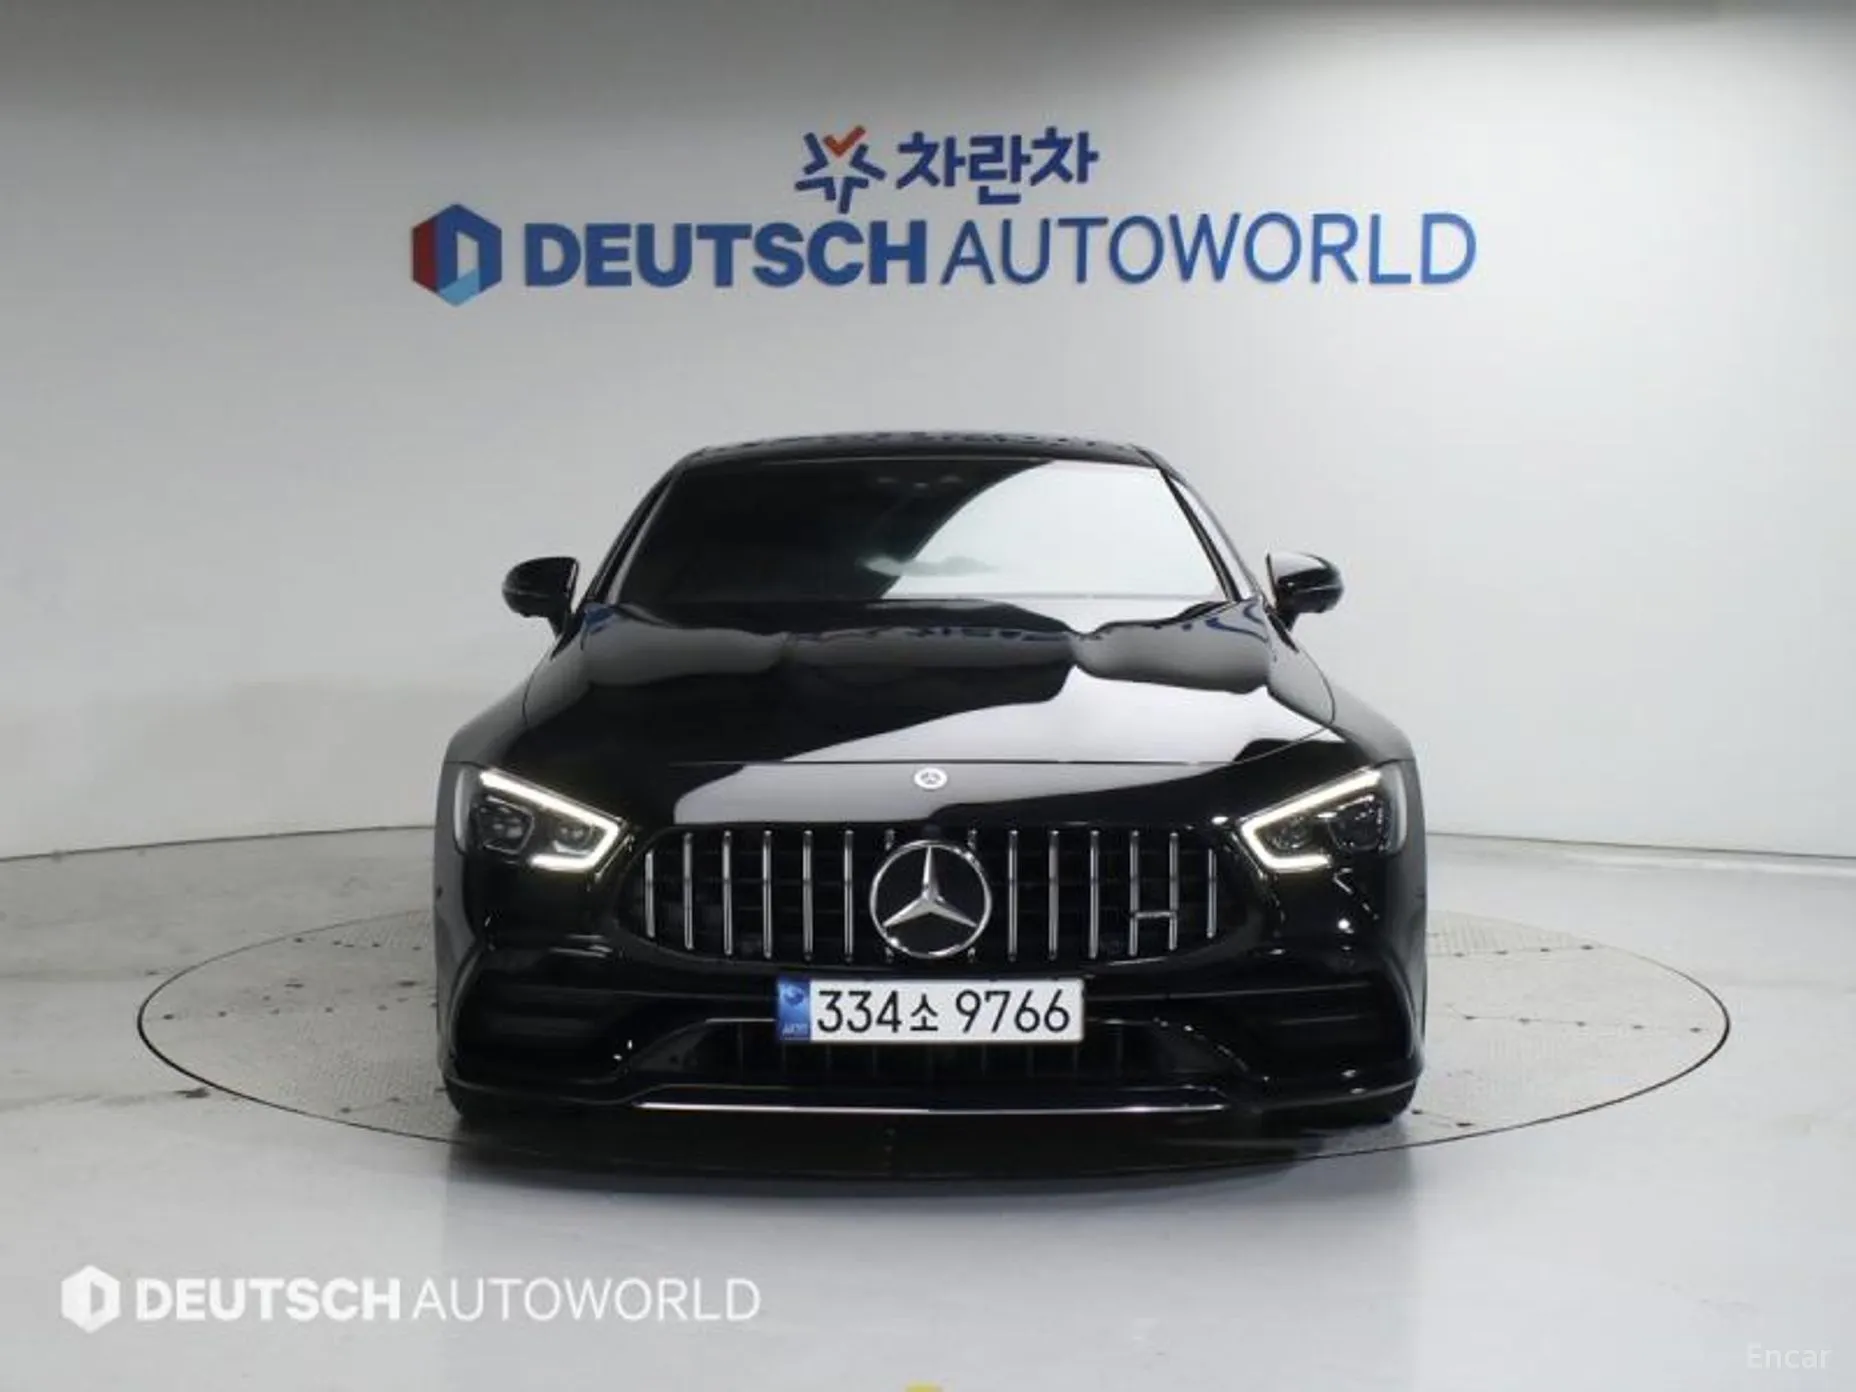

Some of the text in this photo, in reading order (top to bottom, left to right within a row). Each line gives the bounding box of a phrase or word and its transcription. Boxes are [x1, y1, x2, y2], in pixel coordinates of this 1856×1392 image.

[897, 127, 1099, 207] 차란차
[523, 209, 1480, 288] DEUTSCH AUTOWORLD
[817, 989, 1071, 1034] 334소 9766
